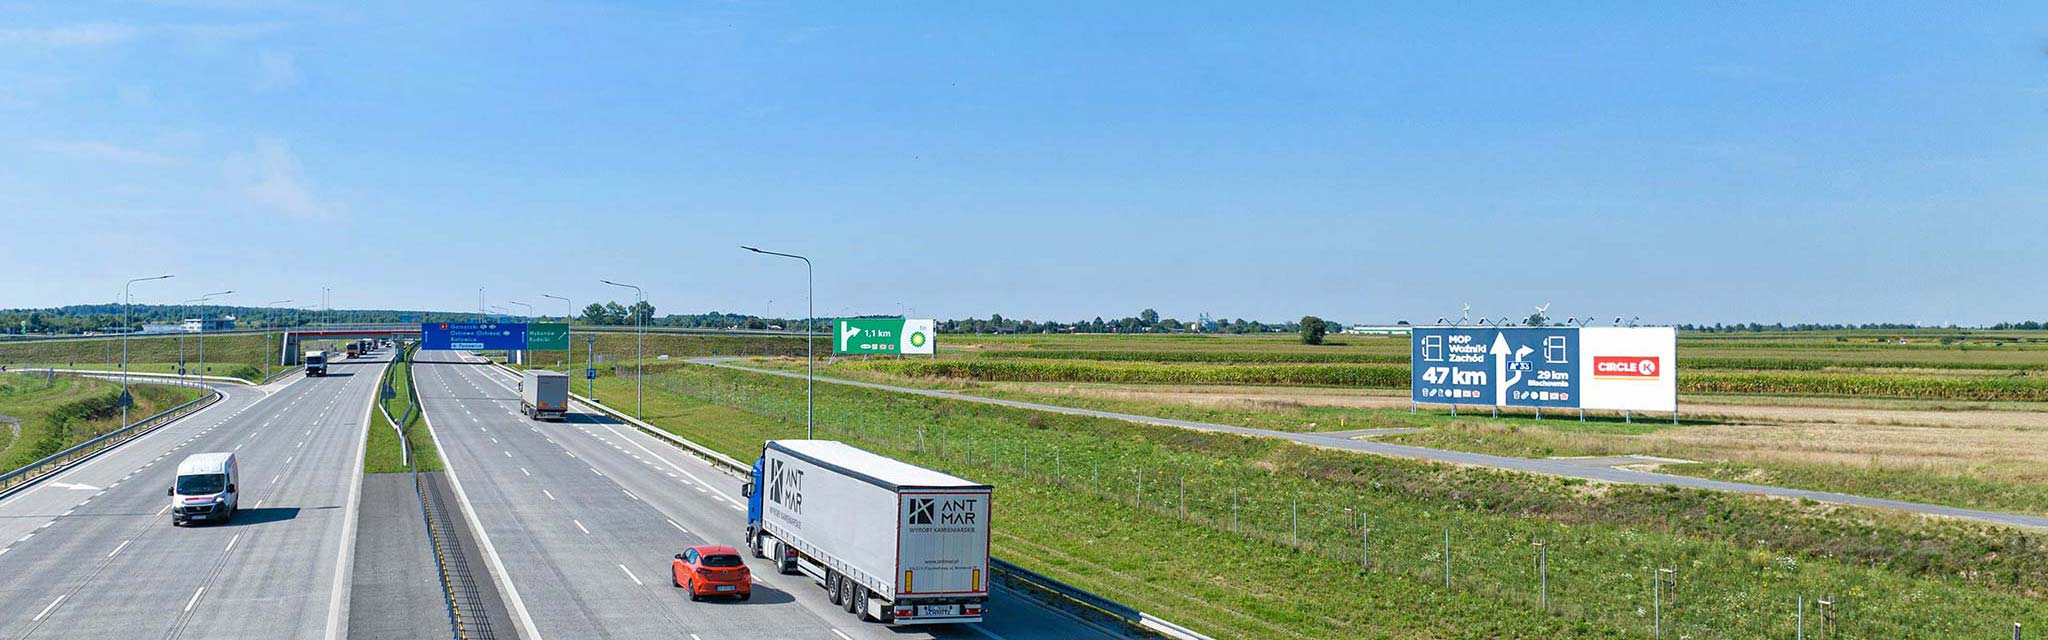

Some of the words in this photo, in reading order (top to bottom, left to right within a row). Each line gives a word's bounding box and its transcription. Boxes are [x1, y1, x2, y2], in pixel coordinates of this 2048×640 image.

[864, 329, 876, 338] 1,1
[877, 329, 891, 337] km
[1448, 334, 1472, 344] MOP
[1448, 343, 1487, 353] Woźniki
[1448, 353, 1485, 362] Zachód
[1597, 361, 1637, 372] CIRCLE
[1422, 366, 1450, 384] 47
[1452, 366, 1487, 385] km
[1537, 370, 1551, 380] 29
[1551, 370, 1569, 380] km
[1527, 379, 1569, 387] Blachownia
[785, 467, 804, 492] ANT
[784, 487, 803, 515] MAR
[941, 499, 977, 512] ANT
[941, 512, 976, 525] MAR
